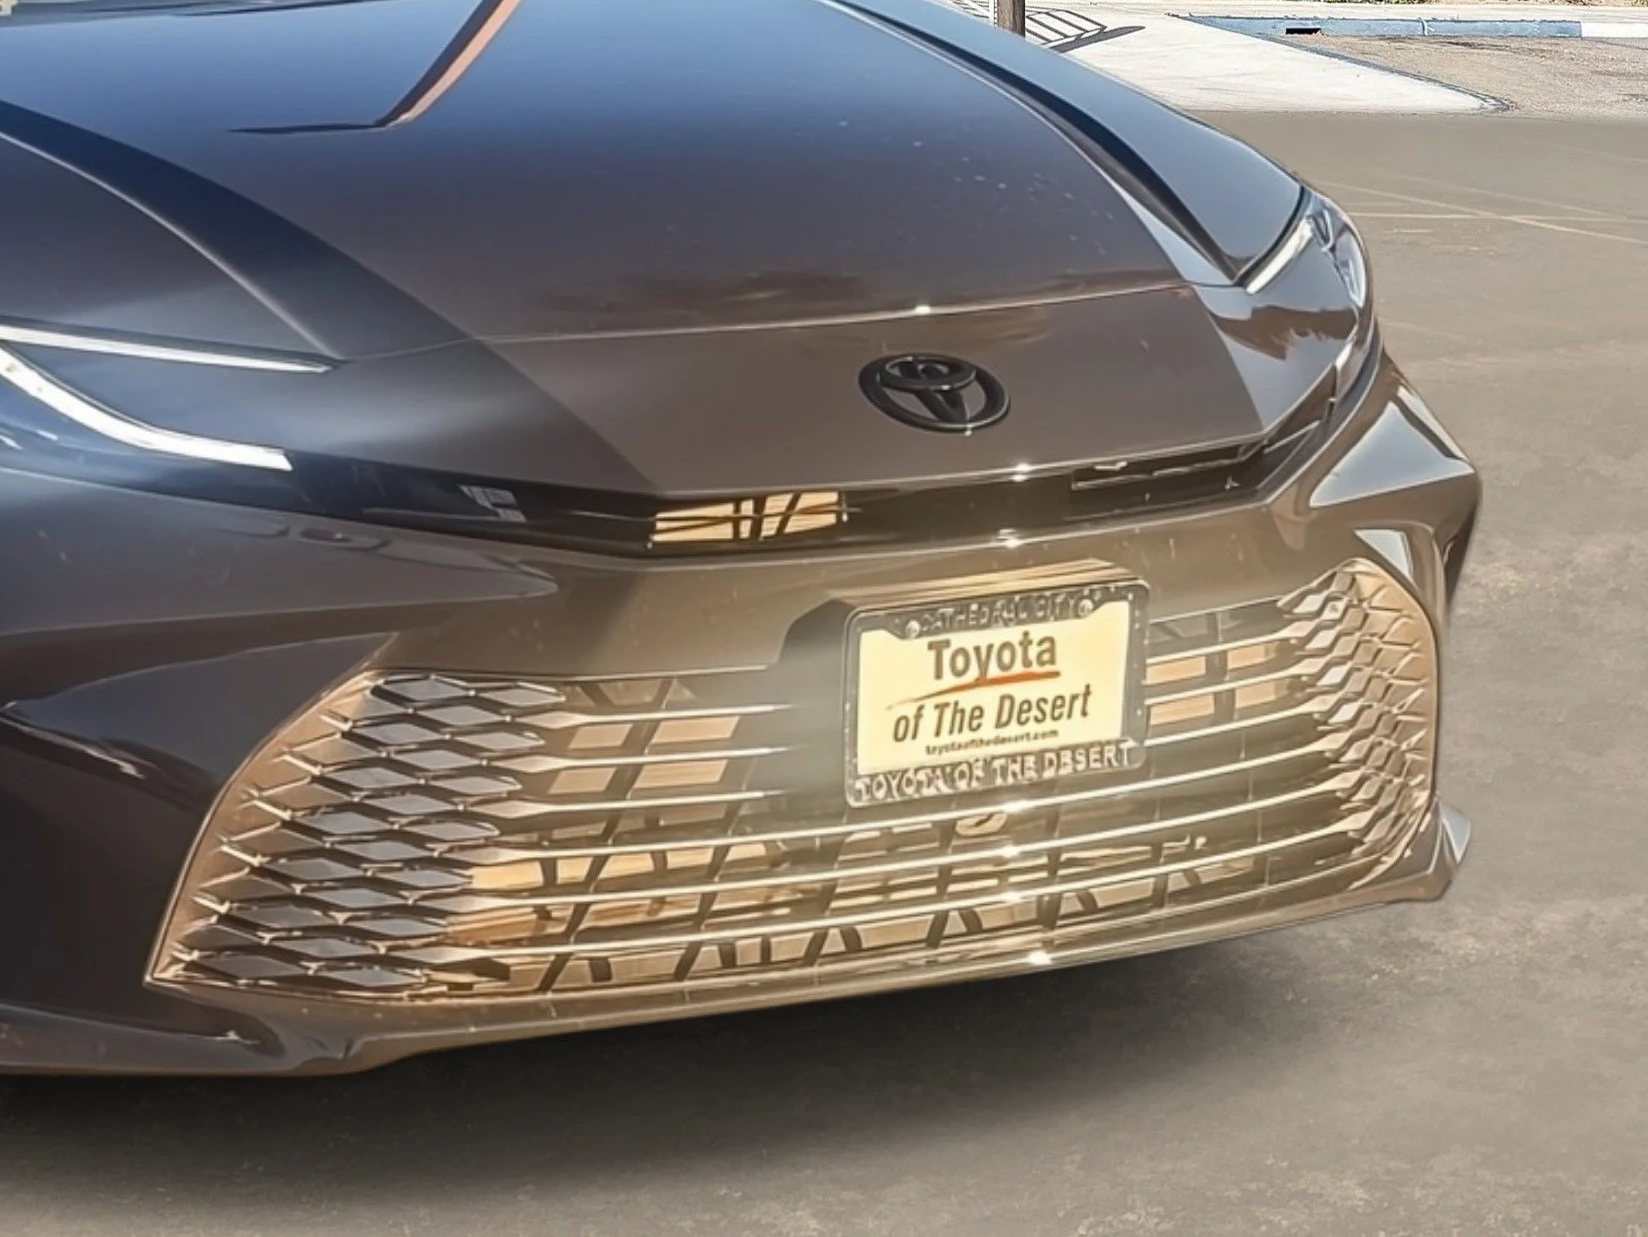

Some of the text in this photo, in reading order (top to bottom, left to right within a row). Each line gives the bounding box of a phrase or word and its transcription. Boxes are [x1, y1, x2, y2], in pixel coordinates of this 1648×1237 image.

[928, 630, 1057, 681] Toyota
[893, 683, 1092, 743] of The Desert
[854, 742, 1131, 802] TOYOTA OF THE DESERT
